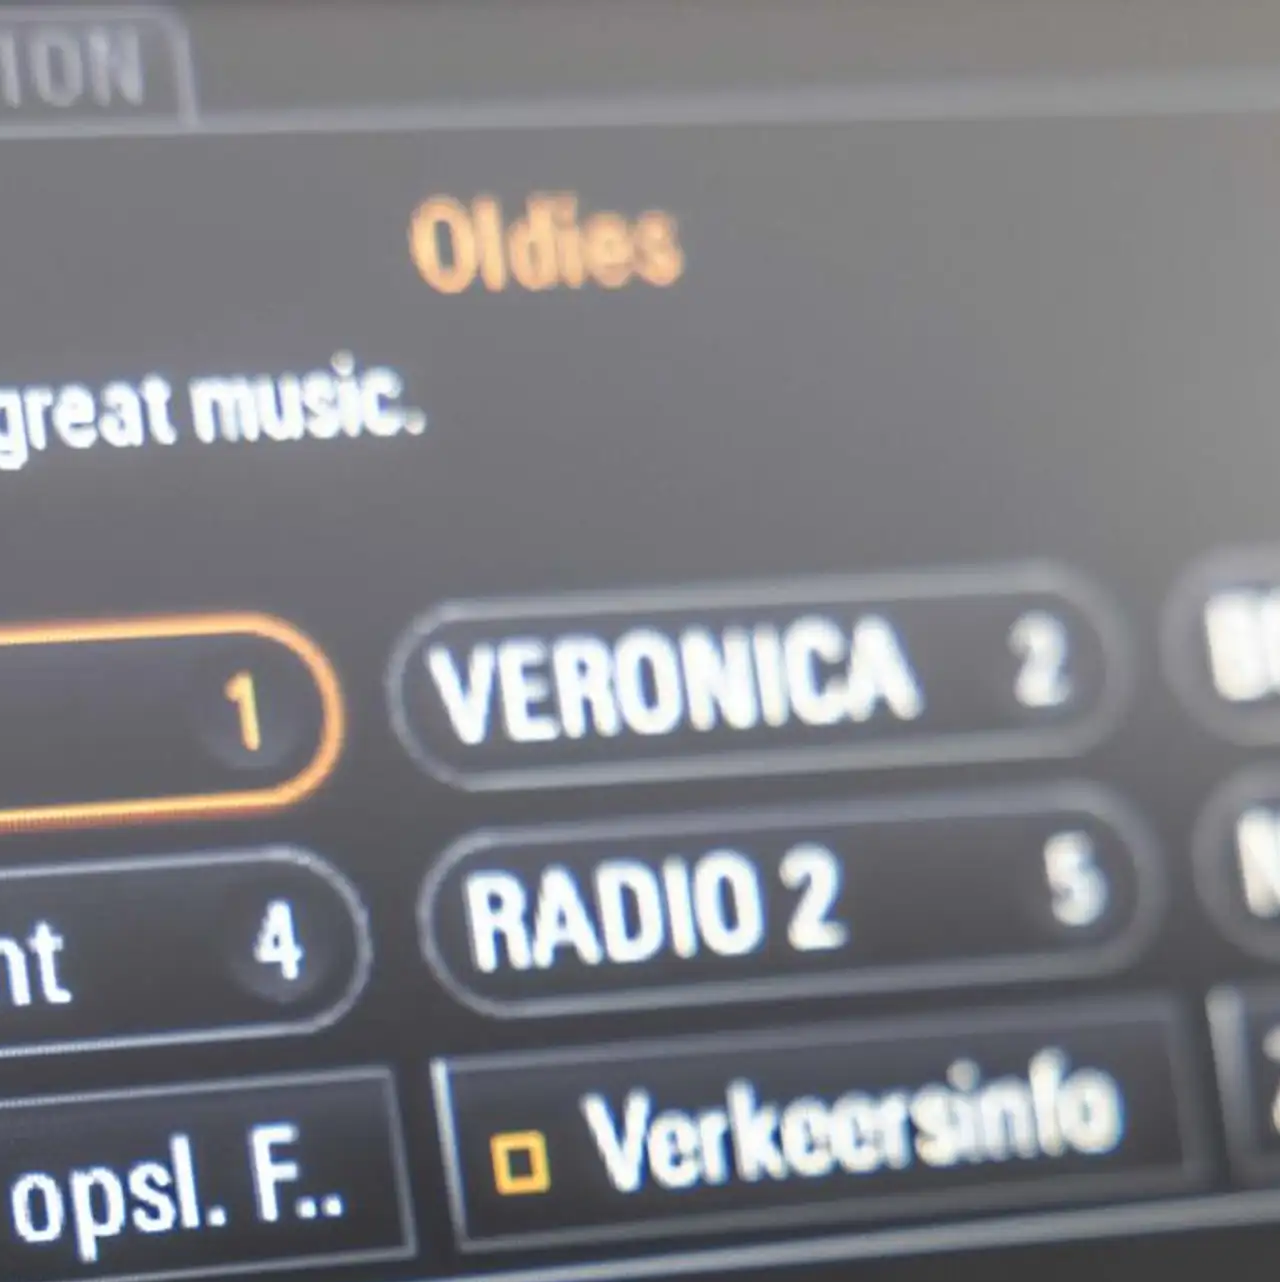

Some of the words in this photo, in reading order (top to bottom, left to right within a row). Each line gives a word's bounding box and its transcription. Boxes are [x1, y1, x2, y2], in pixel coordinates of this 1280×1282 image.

[408, 193, 684, 294] Oldies
[188, 350, 427, 446] music.
[224, 670, 261, 752] 1
[427, 612, 923, 746] VERONICA
[1008, 611, 1072, 708] 2
[253, 899, 304, 980] 4
[463, 856, 766, 973] RADIO
[779, 843, 848, 951] 2
[1042, 829, 1109, 926] 5
[581, 1047, 1126, 1193] Verkeersinfo
[10, 1132, 228, 1262] opsl.
[247, 1121, 344, 1223] F..
